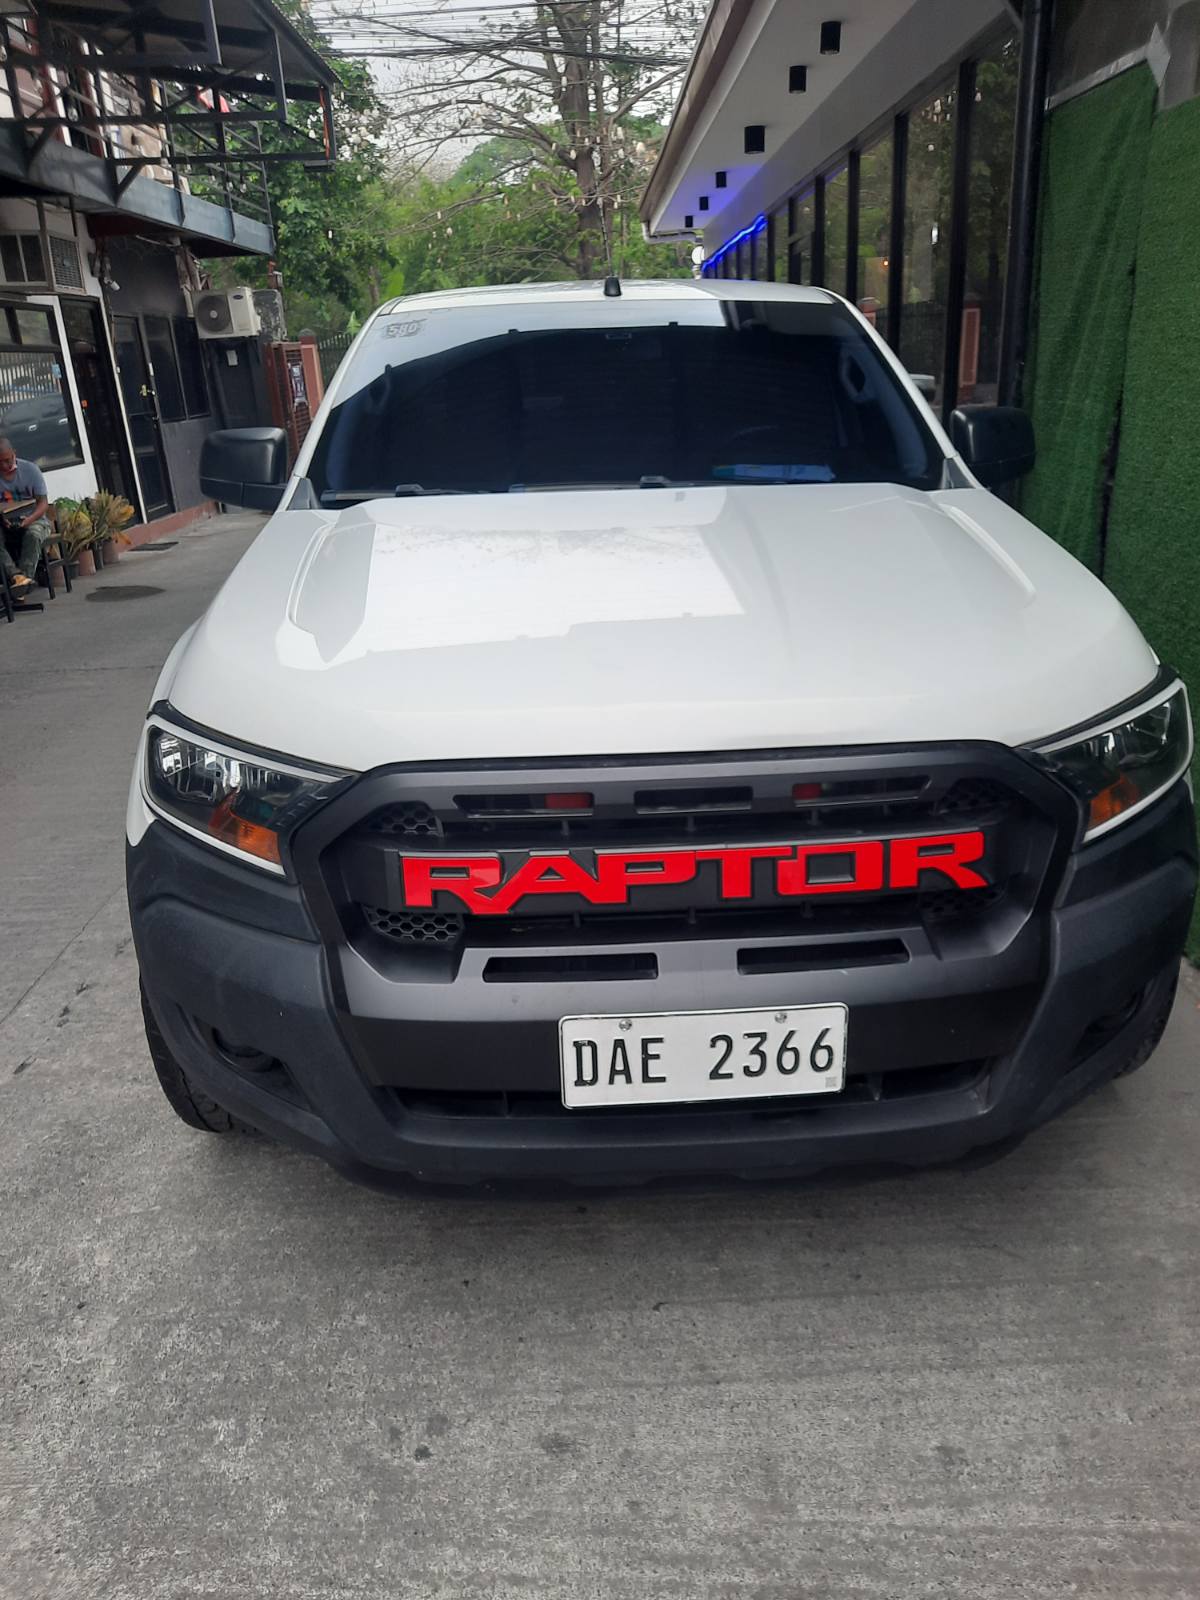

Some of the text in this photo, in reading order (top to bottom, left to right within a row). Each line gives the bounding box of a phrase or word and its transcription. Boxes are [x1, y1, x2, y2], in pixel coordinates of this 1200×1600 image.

[402, 831, 988, 915] RAPTOR
[573, 1028, 835, 1087] DAE 2366
